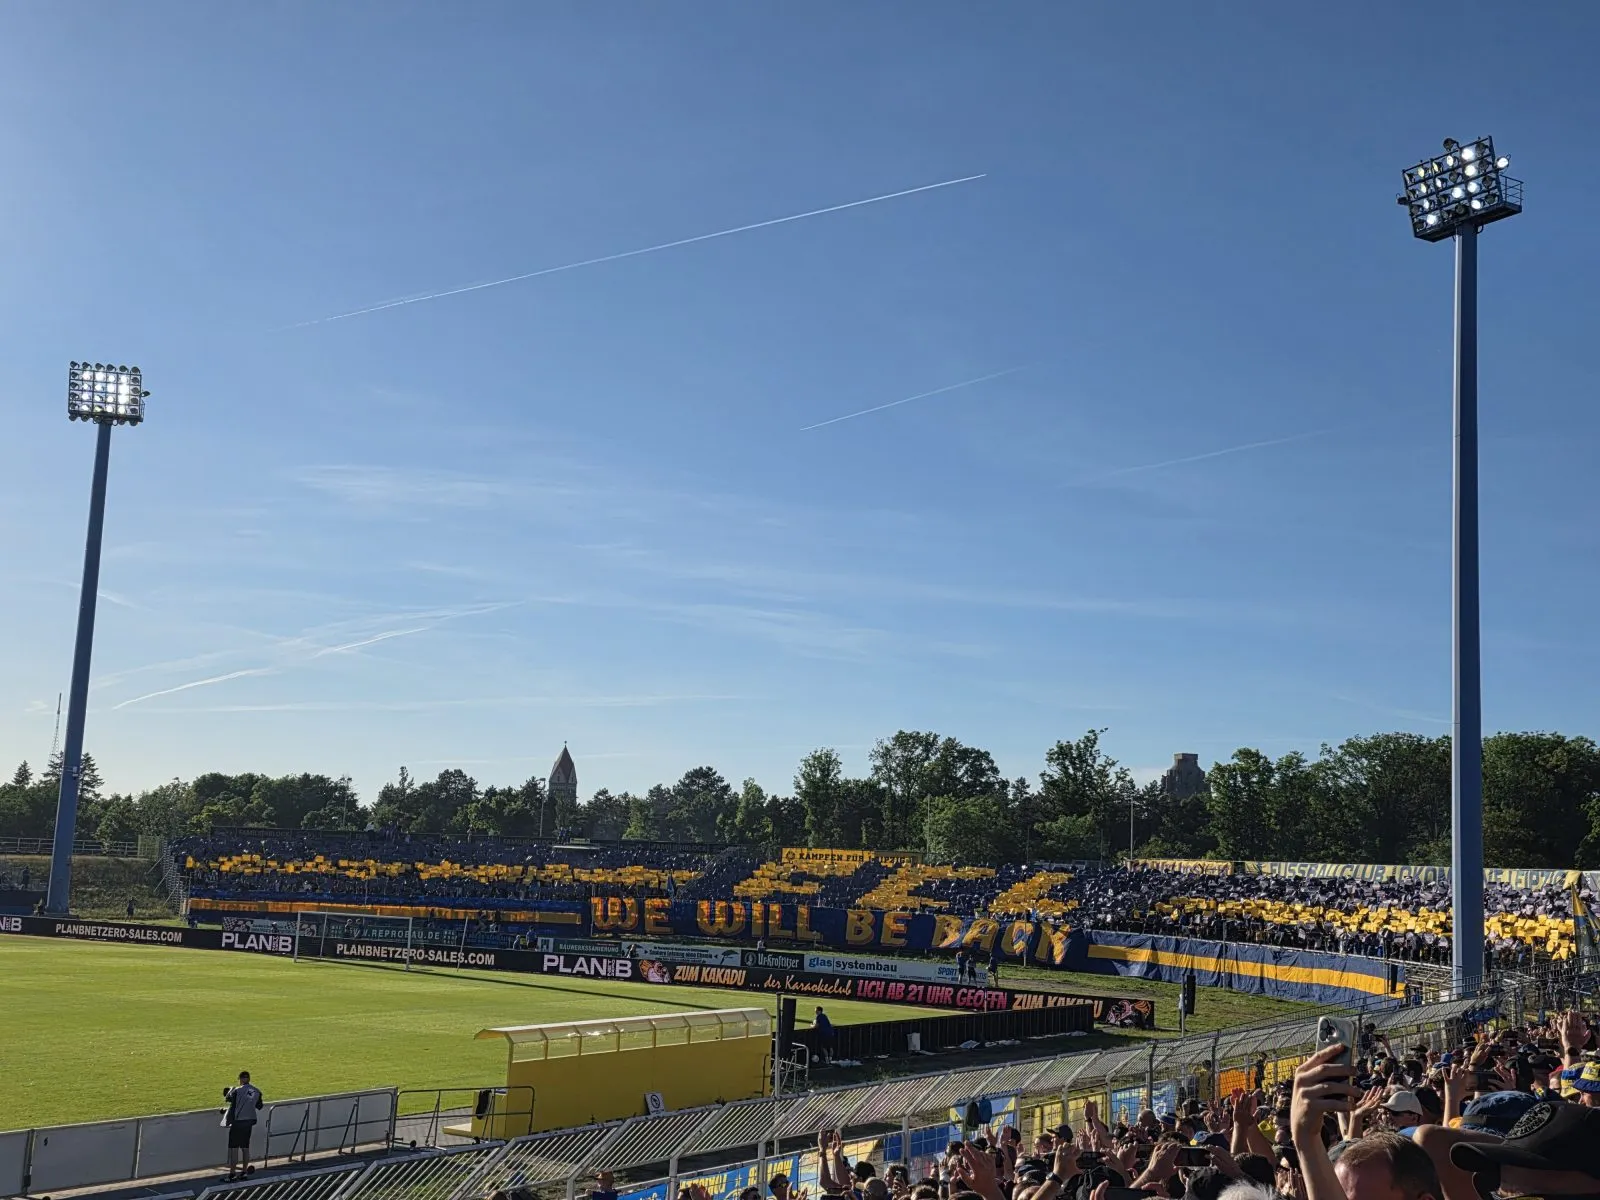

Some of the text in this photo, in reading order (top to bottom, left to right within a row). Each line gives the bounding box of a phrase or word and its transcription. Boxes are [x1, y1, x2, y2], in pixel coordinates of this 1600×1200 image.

[55, 923, 182, 943] PLANBNETZERO-SALES.COM
[591, 896, 674, 934] WE
[697, 899, 823, 942] WILL
[845, 909, 911, 947] BE
[337, 943, 495, 965] PLANBNETZERO-SALES.COM
[674, 965, 700, 982] ZUM
[701, 967, 746, 986] KAKADU
[764, 974, 781, 989] der
[785, 974, 852, 996] Karaokeclub
[886, 981, 905, 1001] AB
[908, 984, 924, 1002] 21
[927, 985, 954, 1005] UHR
[1012, 992, 1044, 1011] ZUM
